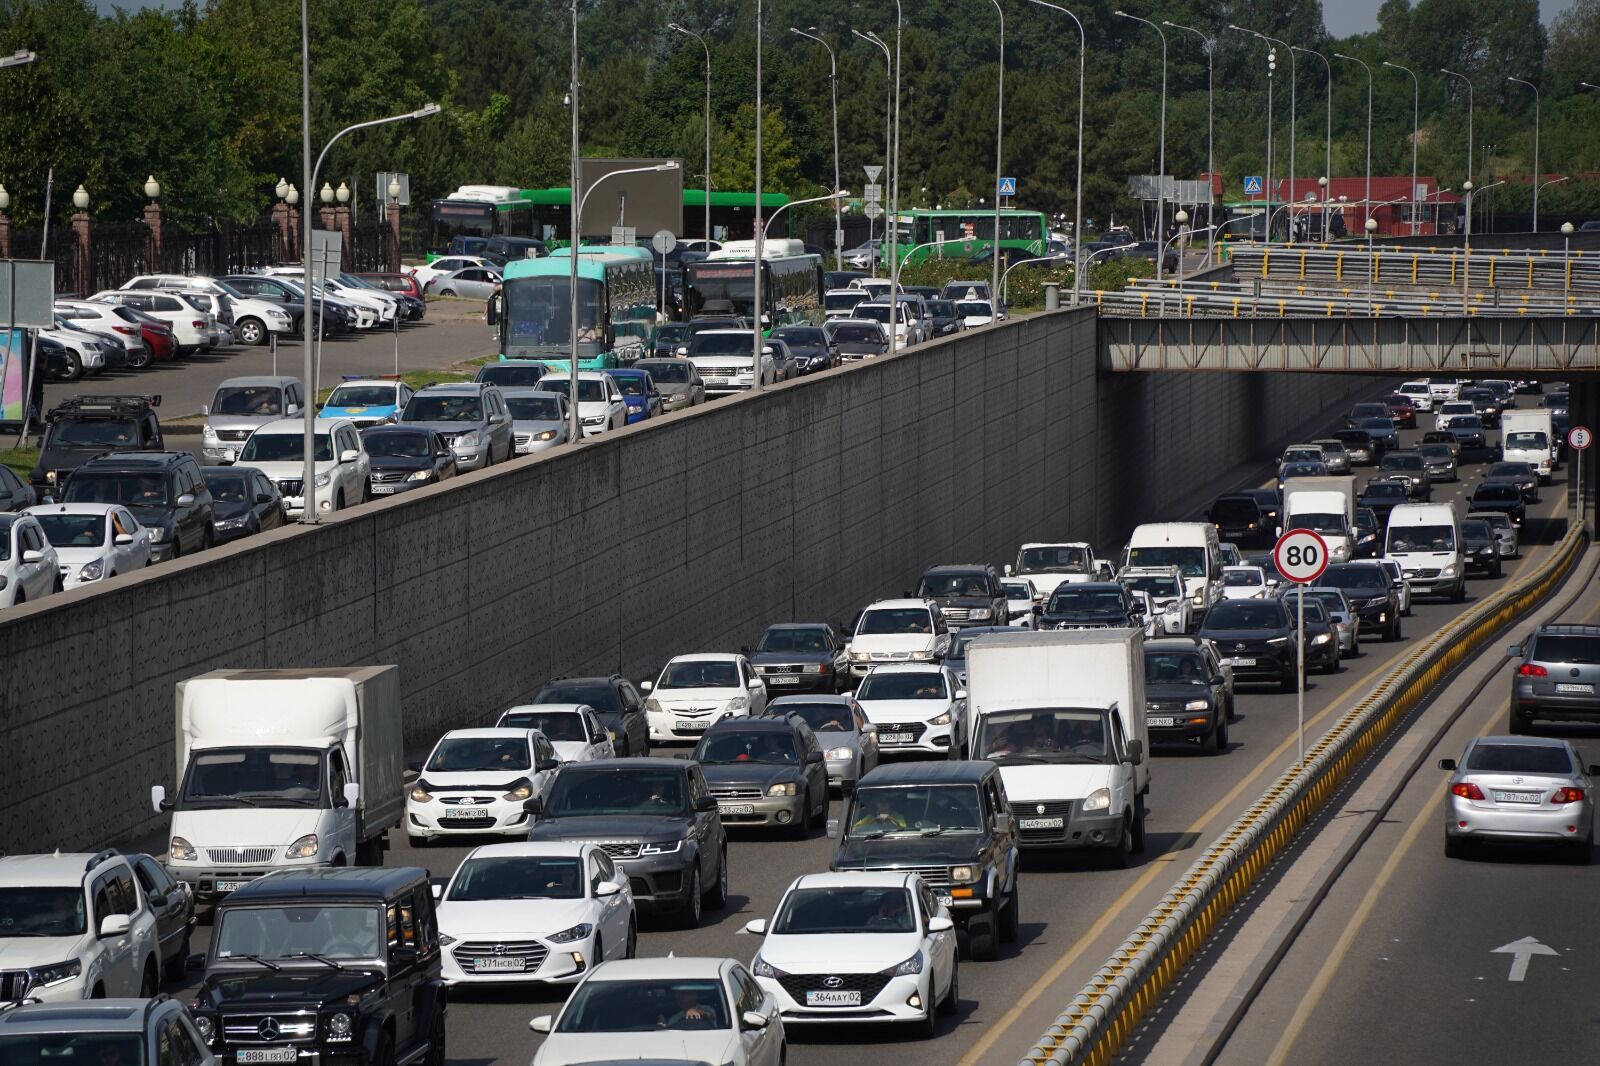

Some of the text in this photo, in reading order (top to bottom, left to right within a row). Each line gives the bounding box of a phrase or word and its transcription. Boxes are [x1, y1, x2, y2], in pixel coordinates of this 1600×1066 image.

[1287, 545, 1318, 567] 80
[477, 809, 486, 817] 05
[1053, 819, 1062, 827] 02
[482, 958, 525, 968] 371HCB 02
[814, 992, 861, 1002] 364AAY 02
[283, 1050, 296, 1061] 02
